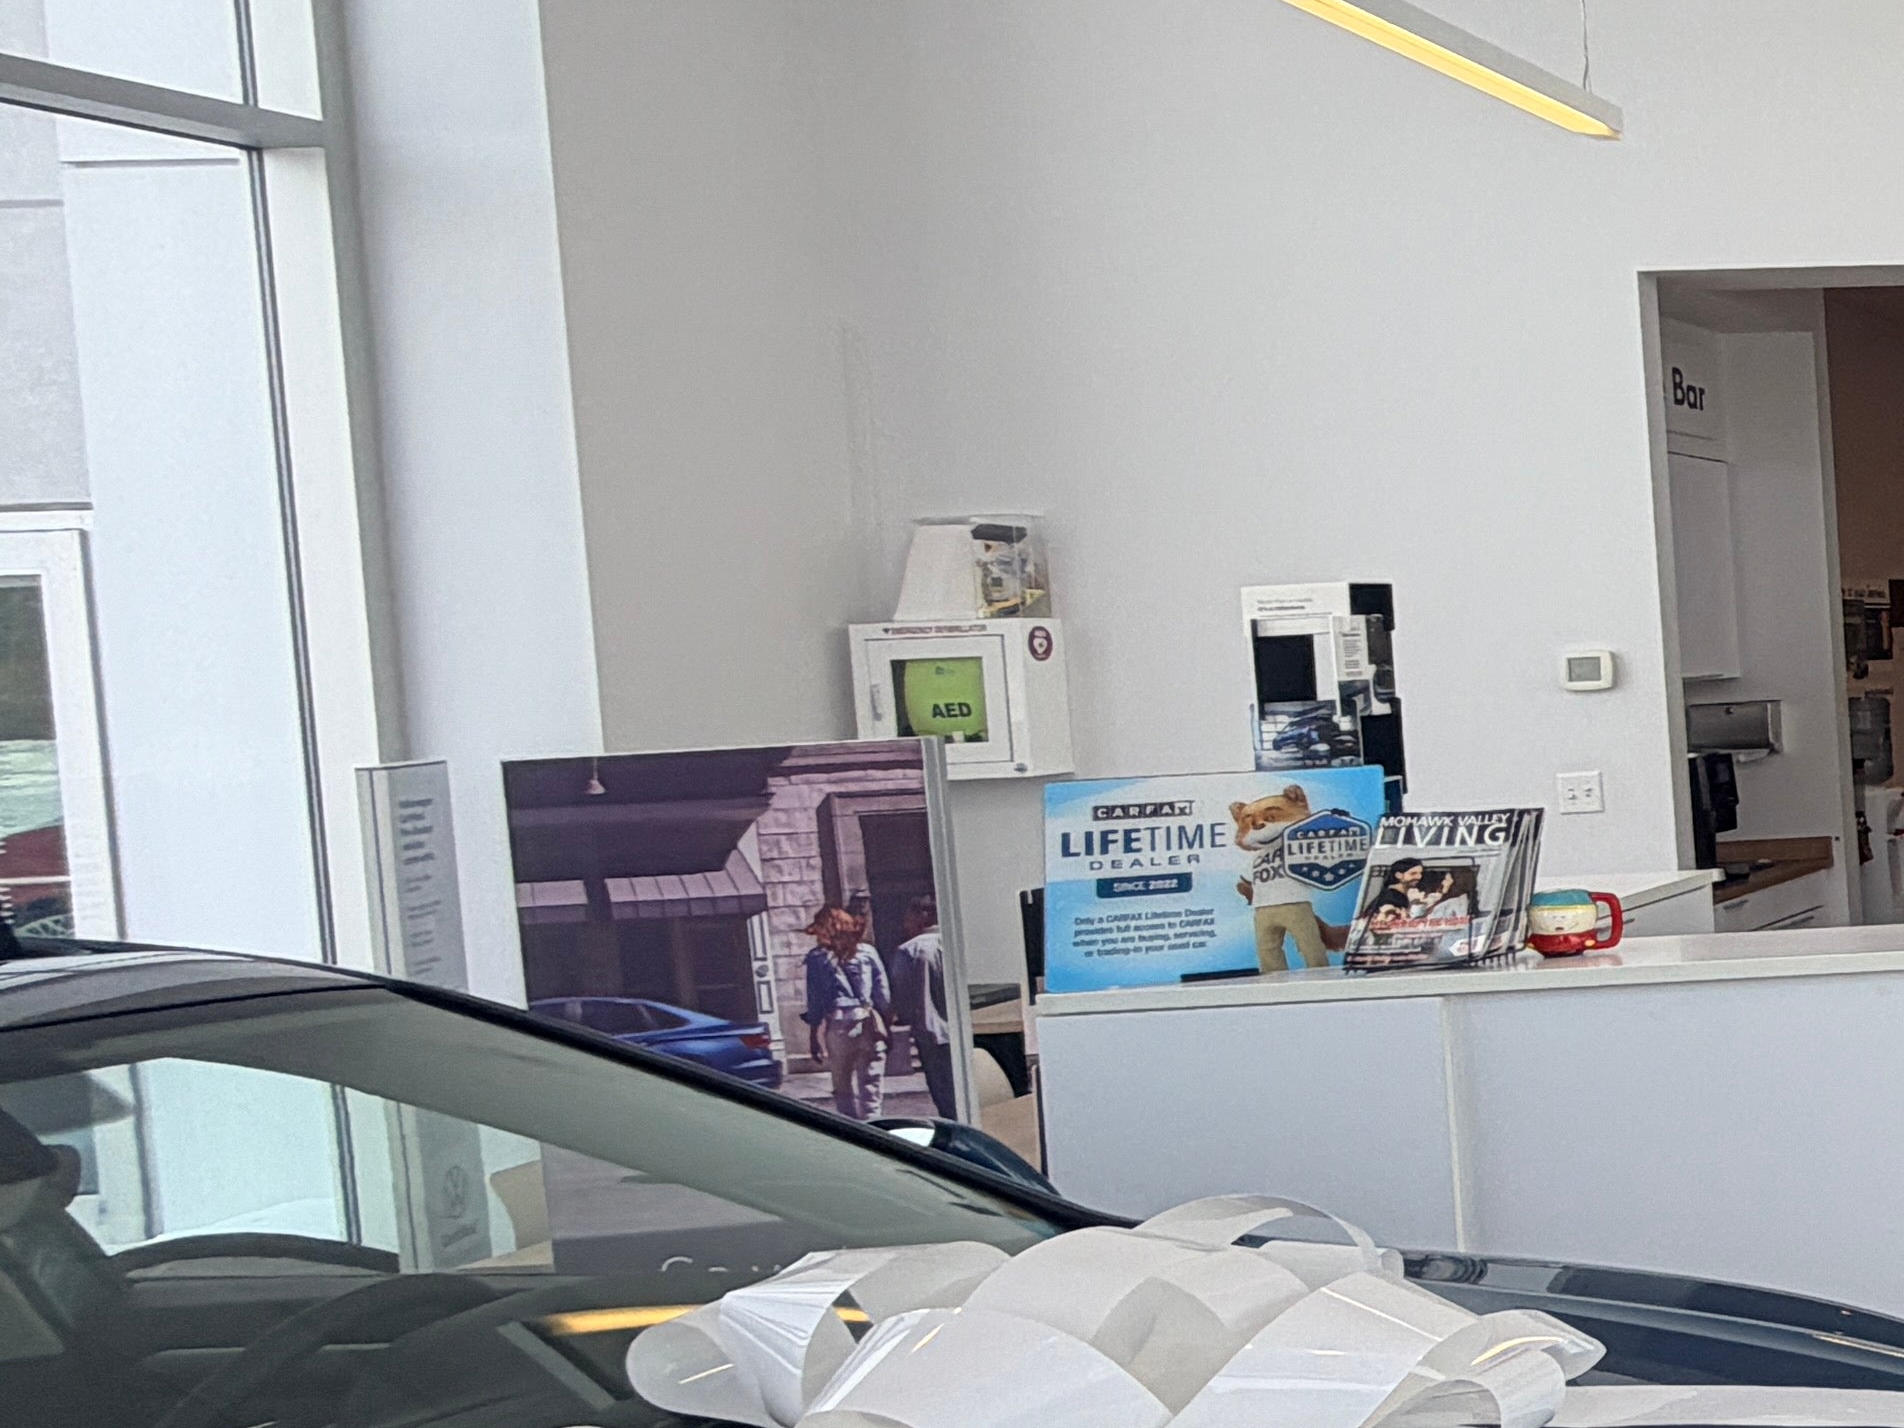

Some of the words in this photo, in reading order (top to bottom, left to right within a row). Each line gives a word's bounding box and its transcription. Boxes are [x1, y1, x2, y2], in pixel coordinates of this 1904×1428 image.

[1672, 366, 1706, 411] Bar
[932, 702, 972, 719] AED
[1093, 802, 1194, 820] CARFAX
[1379, 816, 1453, 828] MOHAWK
[1458, 813, 1510, 826] VALLEY
[1061, 823, 1227, 857] LIFETIME
[1375, 823, 1508, 849] LIVING
[1287, 838, 1368, 856] LIFETIME
[1089, 854, 1200, 871] DEALER
[1253, 866, 1285, 885] FOX
[1074, 917, 1095, 927] Only
